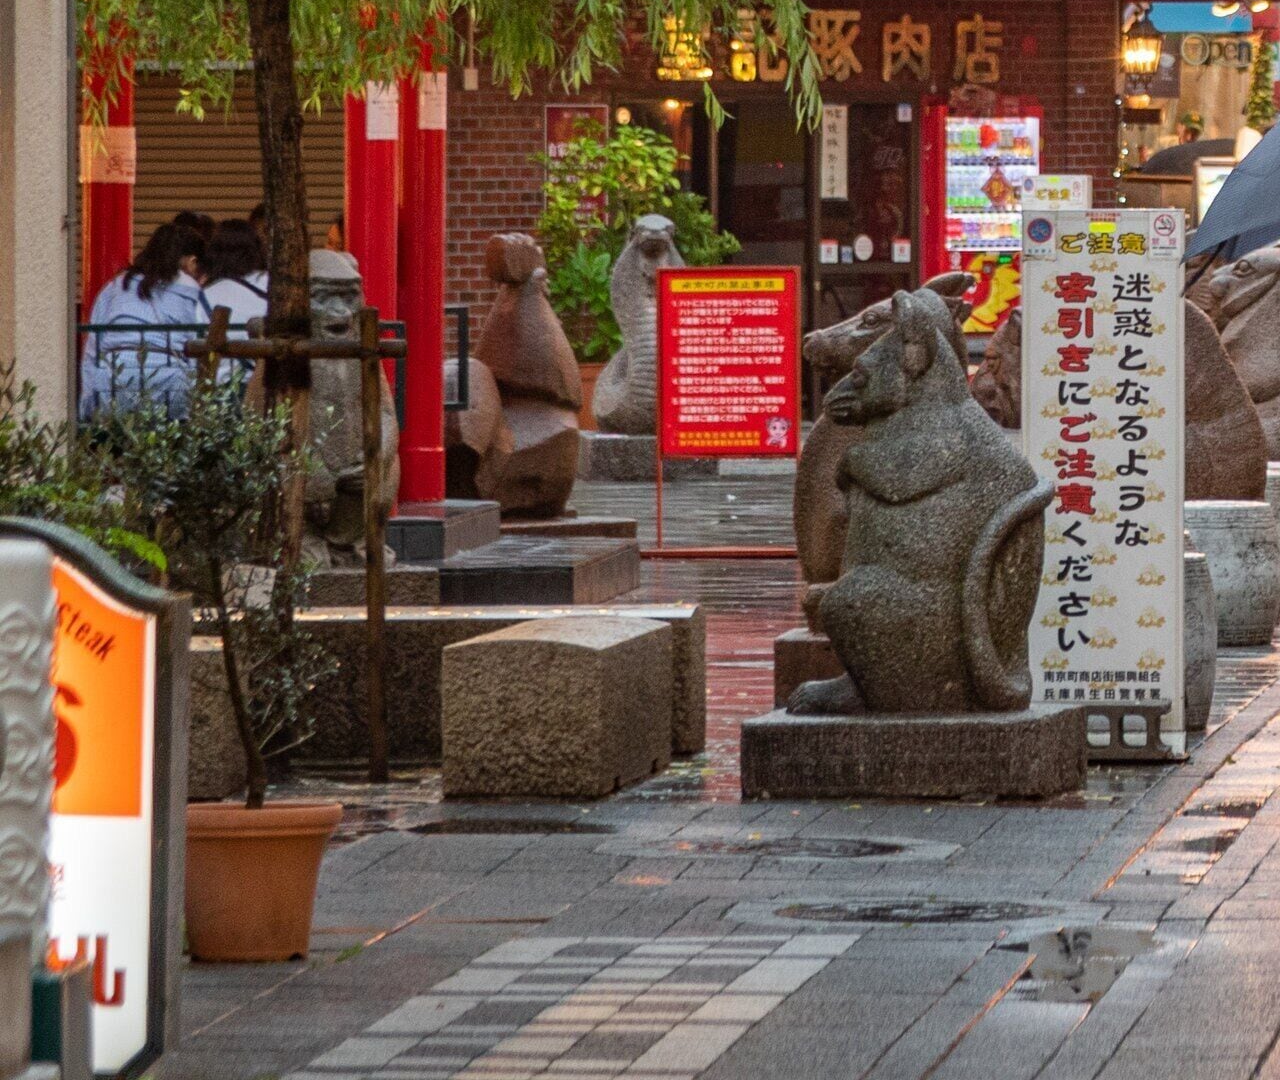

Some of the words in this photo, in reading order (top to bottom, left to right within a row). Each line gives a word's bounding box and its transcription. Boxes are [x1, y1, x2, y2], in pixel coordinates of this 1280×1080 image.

[1181, 33, 1252, 68] Open
[1060, 232, 1147, 256] ご注意
[1113, 272, 1155, 547] 迷惑となるような
[1054, 272, 1099, 653] 客引きにご注意ください
[1043, 670, 1162, 684] 南京町商店街振興組合
[1043, 687, 1162, 701] 兵庫県生田警察署
